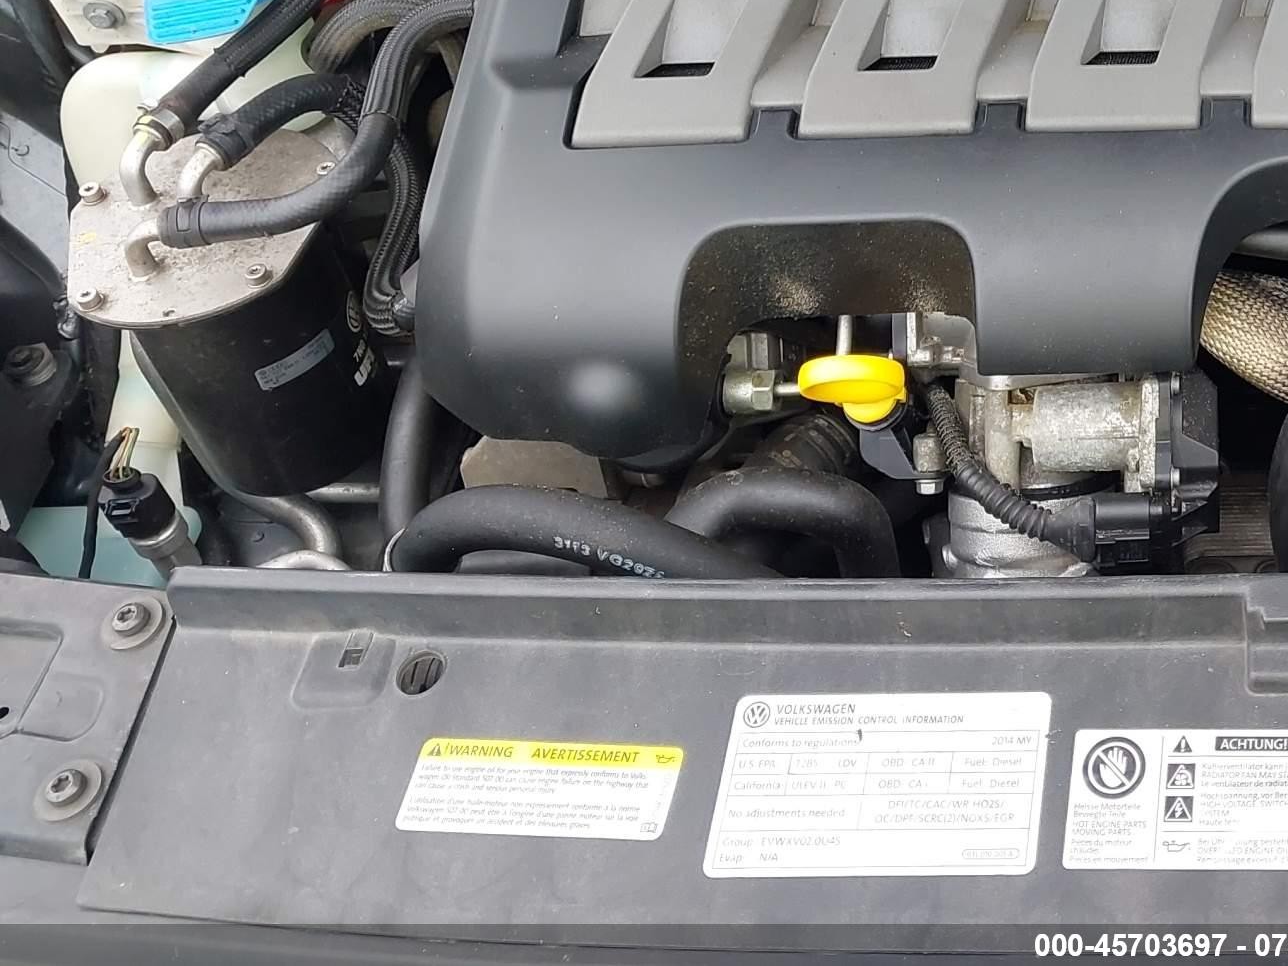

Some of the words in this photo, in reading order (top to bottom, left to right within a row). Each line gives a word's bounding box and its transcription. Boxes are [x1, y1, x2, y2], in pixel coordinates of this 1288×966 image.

[777, 703, 855, 715] VOLKSWAGEN
[775, 717, 808, 725] VEHICLE
[812, 717, 853, 725] EMISSION
[858, 715, 898, 725] CONTROL
[903, 715, 964, 723] INFORMATION
[743, 739, 789, 747] Conforms
[792, 738, 801, 747] to
[1017, 736, 1031, 744] MY
[1221, 739, 1287, 749] ACHTUNG!
[450, 745, 514, 758] WARNING
[531, 748, 640, 762] AVERTISSEMENT
[729, 809, 742, 817] No
[746, 808, 806, 819] adjustments
